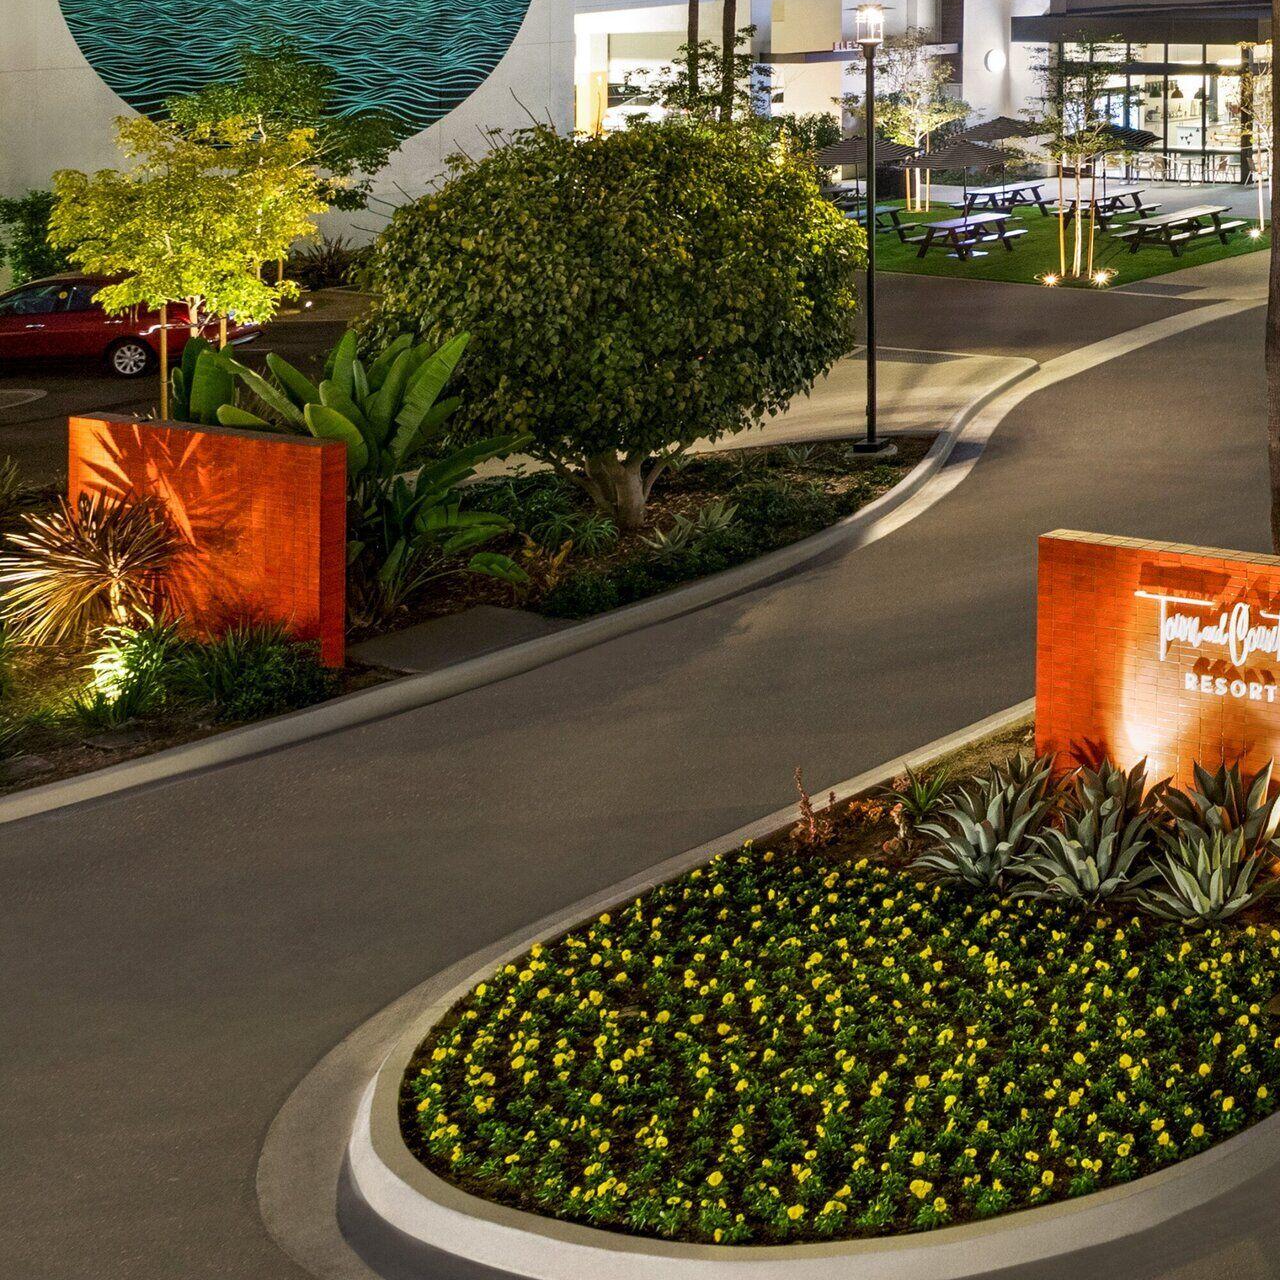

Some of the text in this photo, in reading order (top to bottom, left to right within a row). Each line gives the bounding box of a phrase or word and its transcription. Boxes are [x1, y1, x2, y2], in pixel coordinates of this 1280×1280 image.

[1134, 590, 1216, 662] Town
[1201, 612, 1229, 646] and
[1184, 672, 1278, 703] RESORT
